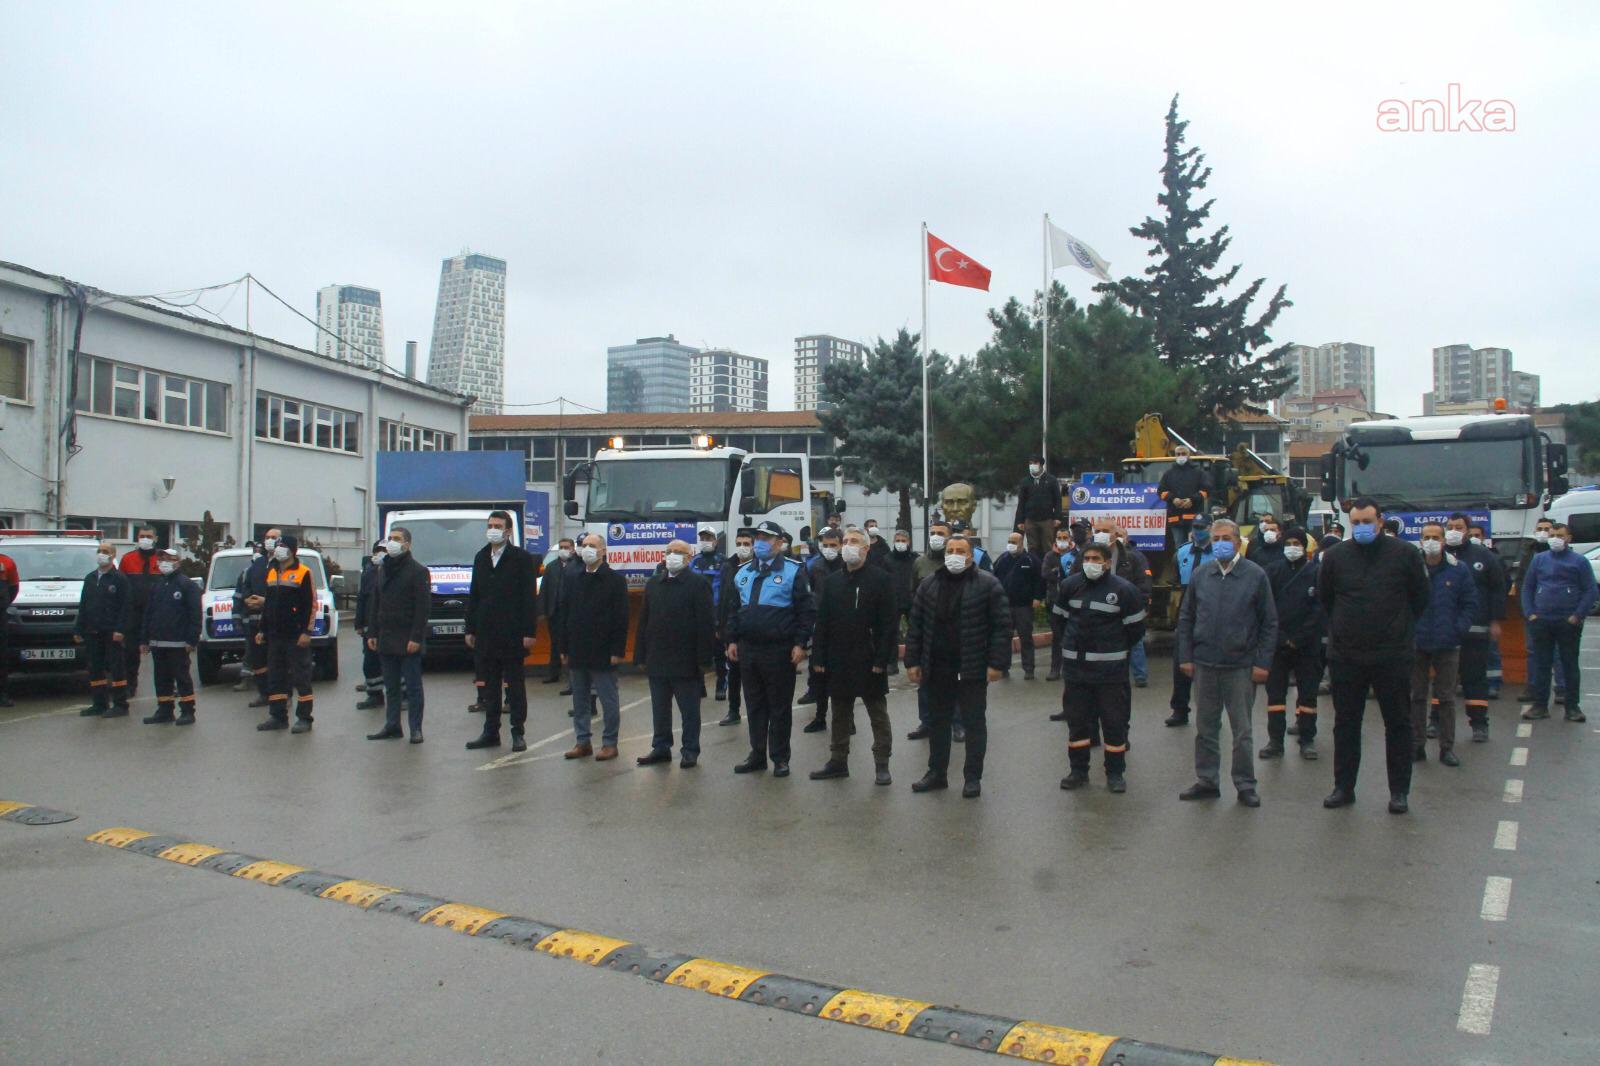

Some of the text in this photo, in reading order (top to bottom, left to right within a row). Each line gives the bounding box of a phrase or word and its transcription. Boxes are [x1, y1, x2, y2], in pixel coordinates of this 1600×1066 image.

[1099, 487, 1136, 495] KARTAL
[1089, 495, 1145, 504] BELEDİYESİ
[1414, 516, 1450, 524] KARTA
[633, 523, 668, 531] KARTAL
[625, 529, 676, 540] BELEDİYESİ
[608, 547, 666, 564] KARLA MÜCADE
[216, 624, 233, 632] 444
